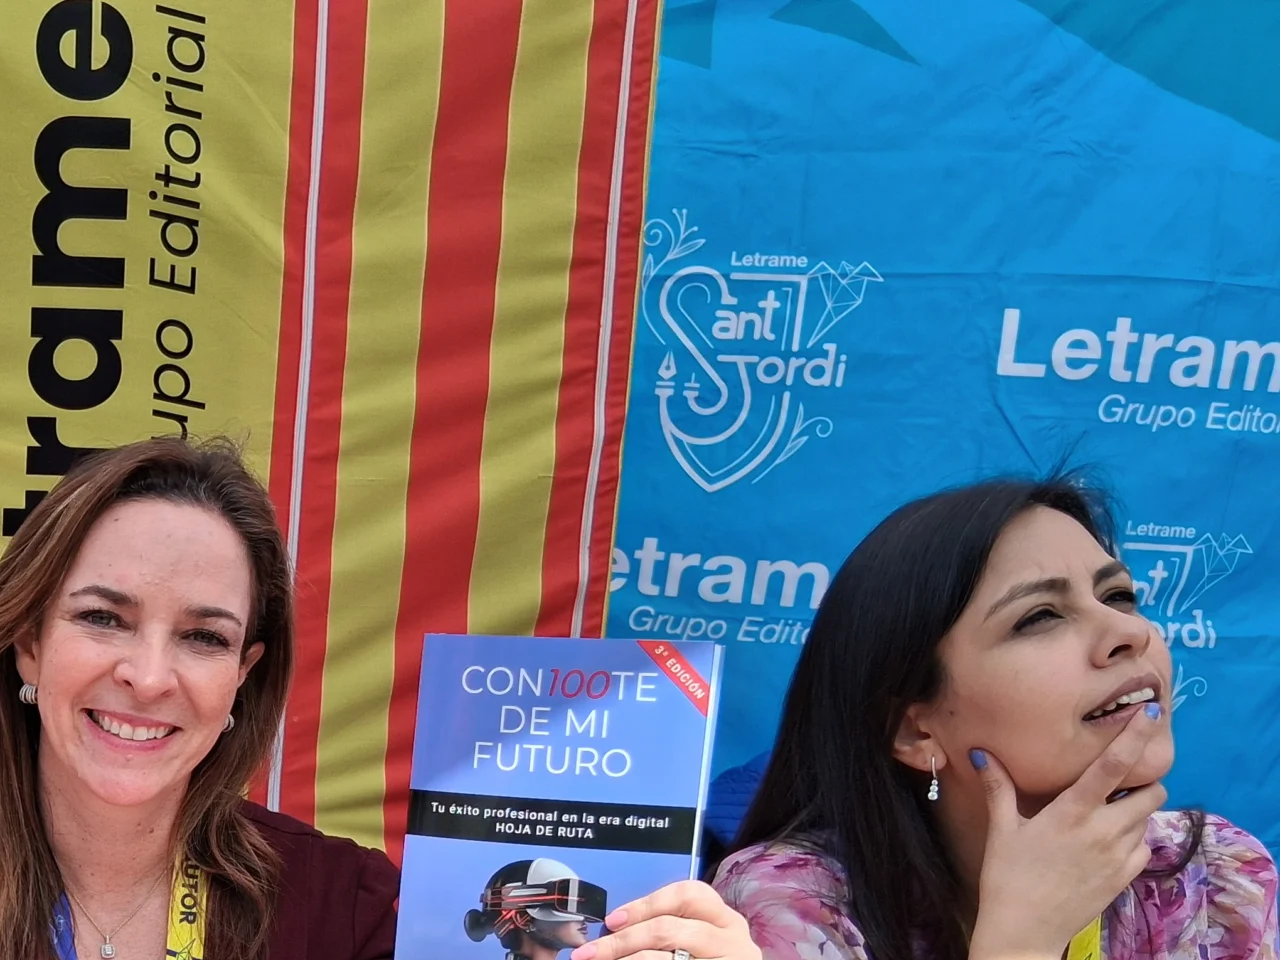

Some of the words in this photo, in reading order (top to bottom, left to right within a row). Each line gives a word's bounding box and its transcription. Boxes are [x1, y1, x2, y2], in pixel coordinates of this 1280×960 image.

[148, 4, 207, 294] Editorial
[2, 0, 134, 536] rame
[730, 251, 808, 267] Letrame
[151, 319, 207, 442] upo
[1098, 394, 1195, 432] Grupo
[1205, 402, 1280, 434] Edito
[1125, 520, 1196, 538] Letrame
[610, 537, 830, 610] etram
[629, 605, 727, 640] Grupo
[461, 665, 658, 702] CON100TE
[665, 653, 706, 700] EDICIÓN
[499, 706, 550, 737] DE
[565, 709, 610, 739] MI
[473, 742, 632, 778] FUTURO
[431, 802, 446, 815] Tu
[449, 804, 480, 817] éxito
[484, 806, 558, 823] profesional
[562, 812, 579, 823] en
[582, 812, 595, 824] la
[599, 816, 620, 826] era
[625, 816, 669, 829] digital
[496, 823, 532, 836] HOJA
[536, 825, 553, 837] DE
[557, 826, 594, 839] RUTA
[179, 864, 200, 925] UTOR
